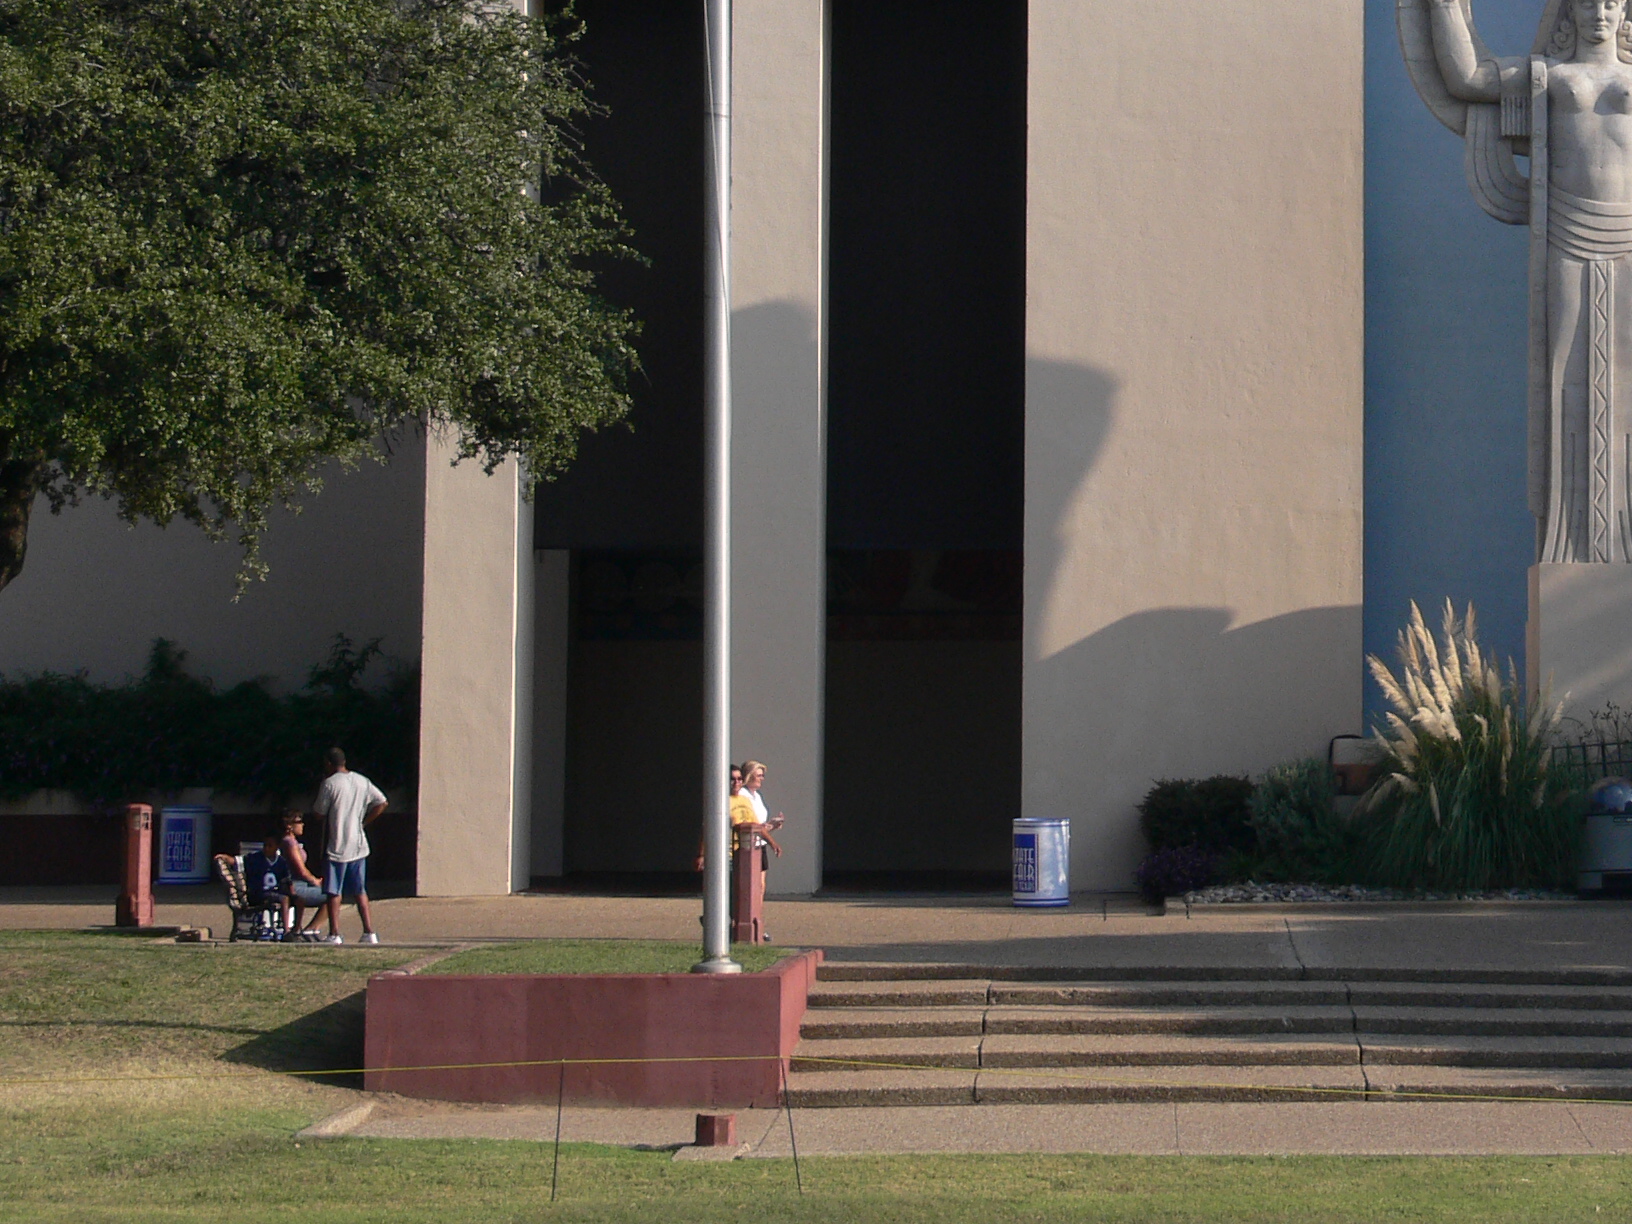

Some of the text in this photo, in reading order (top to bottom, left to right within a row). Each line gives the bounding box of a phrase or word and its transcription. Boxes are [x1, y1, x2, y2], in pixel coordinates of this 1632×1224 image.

[166, 832, 191, 845] STATE
[167, 846, 191, 861] FAIR
[1014, 864, 1035, 880] FAIR
